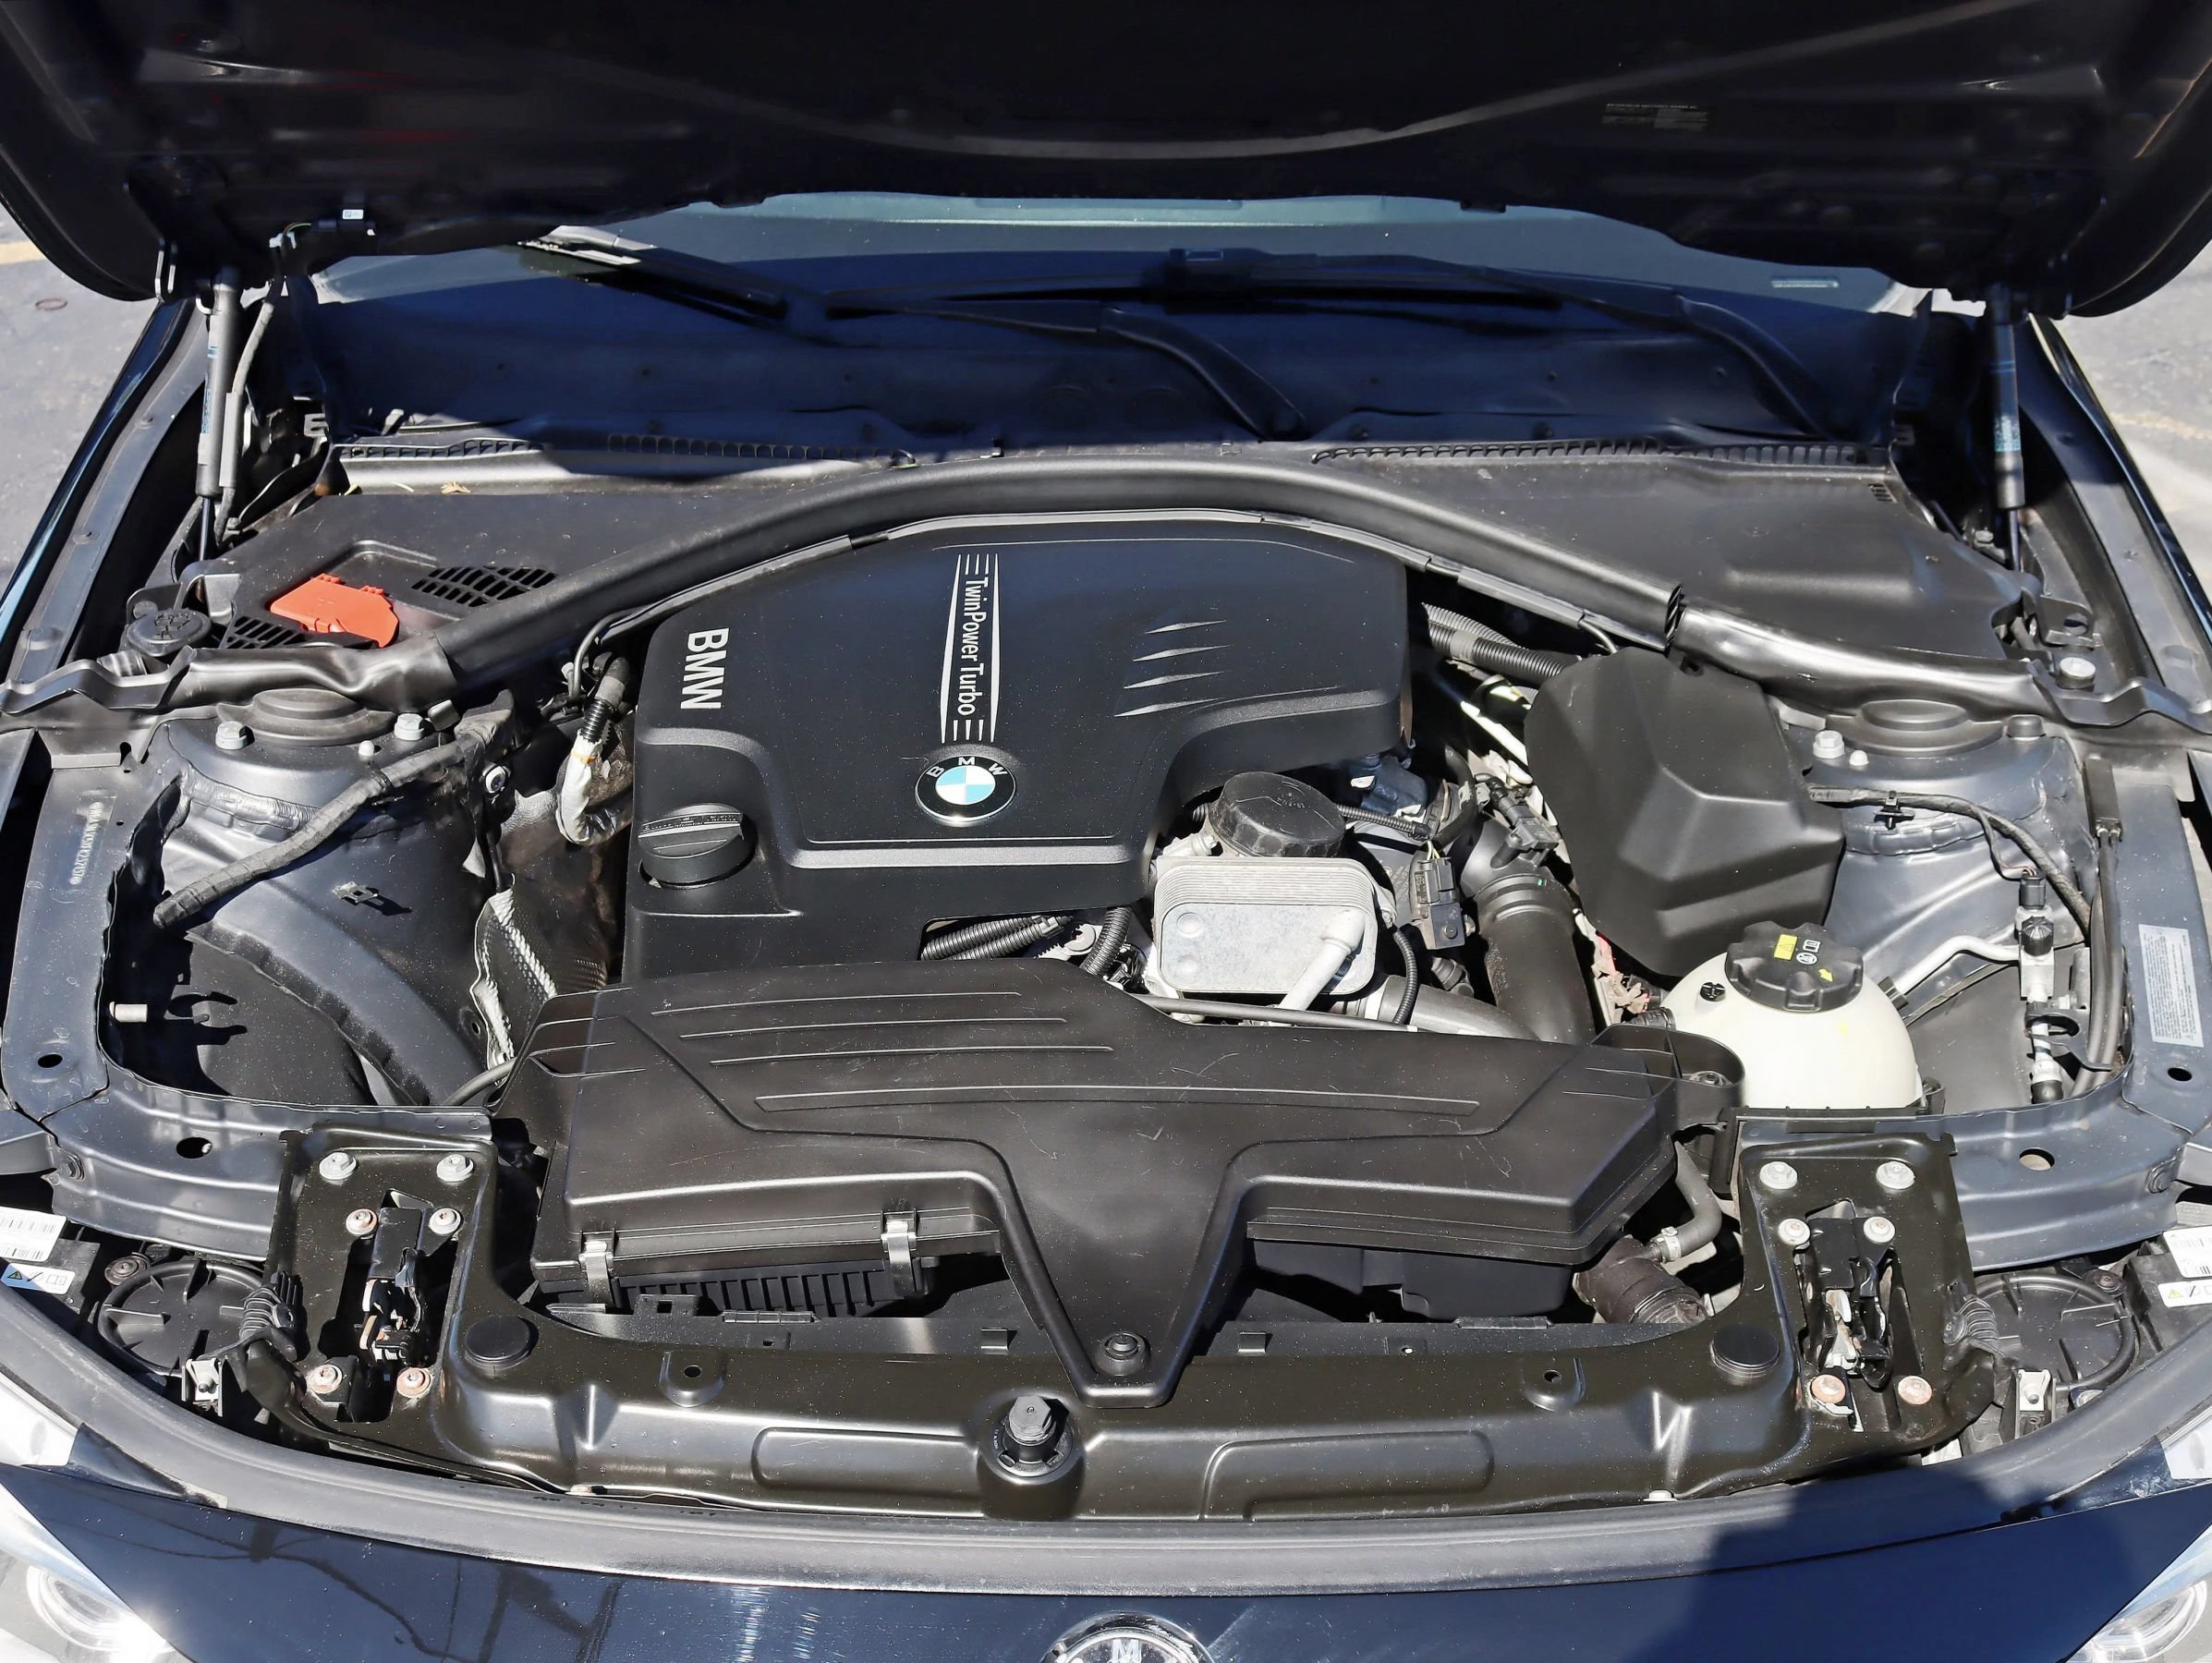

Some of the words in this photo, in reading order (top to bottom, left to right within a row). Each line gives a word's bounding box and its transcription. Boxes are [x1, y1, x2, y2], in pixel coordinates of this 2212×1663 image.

[961, 577, 989, 662] TwinPower
[680, 628, 729, 710] BMW
[957, 663, 985, 716] Turbo
[927, 757, 1008, 778] BMW
